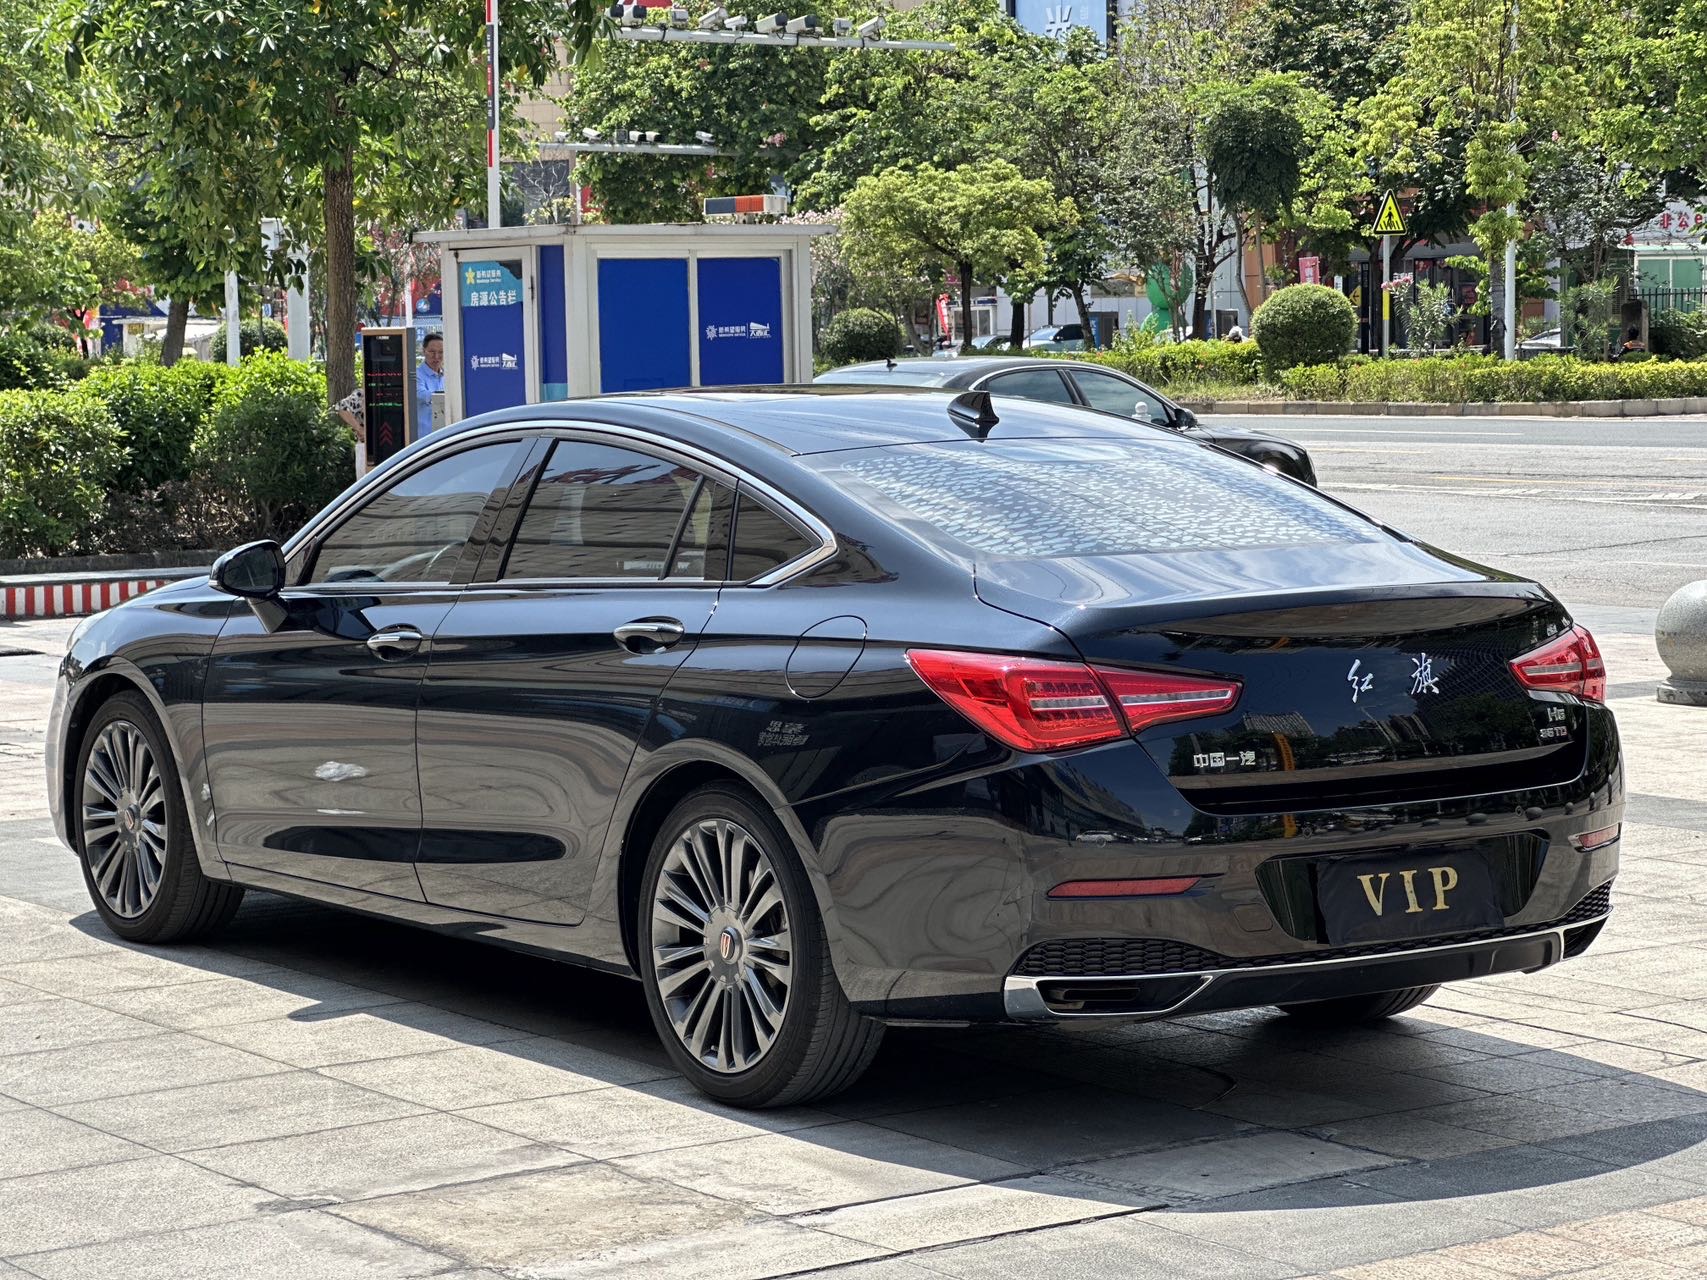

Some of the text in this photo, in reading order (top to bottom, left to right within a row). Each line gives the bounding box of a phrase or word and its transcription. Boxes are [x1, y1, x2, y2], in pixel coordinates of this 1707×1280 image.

[470, 289, 517, 306] 房源公告栏
[1347, 652, 1440, 703] 红旗
[1193, 750, 1257, 768] 中国一汽
[1357, 866, 1458, 917] VIP
